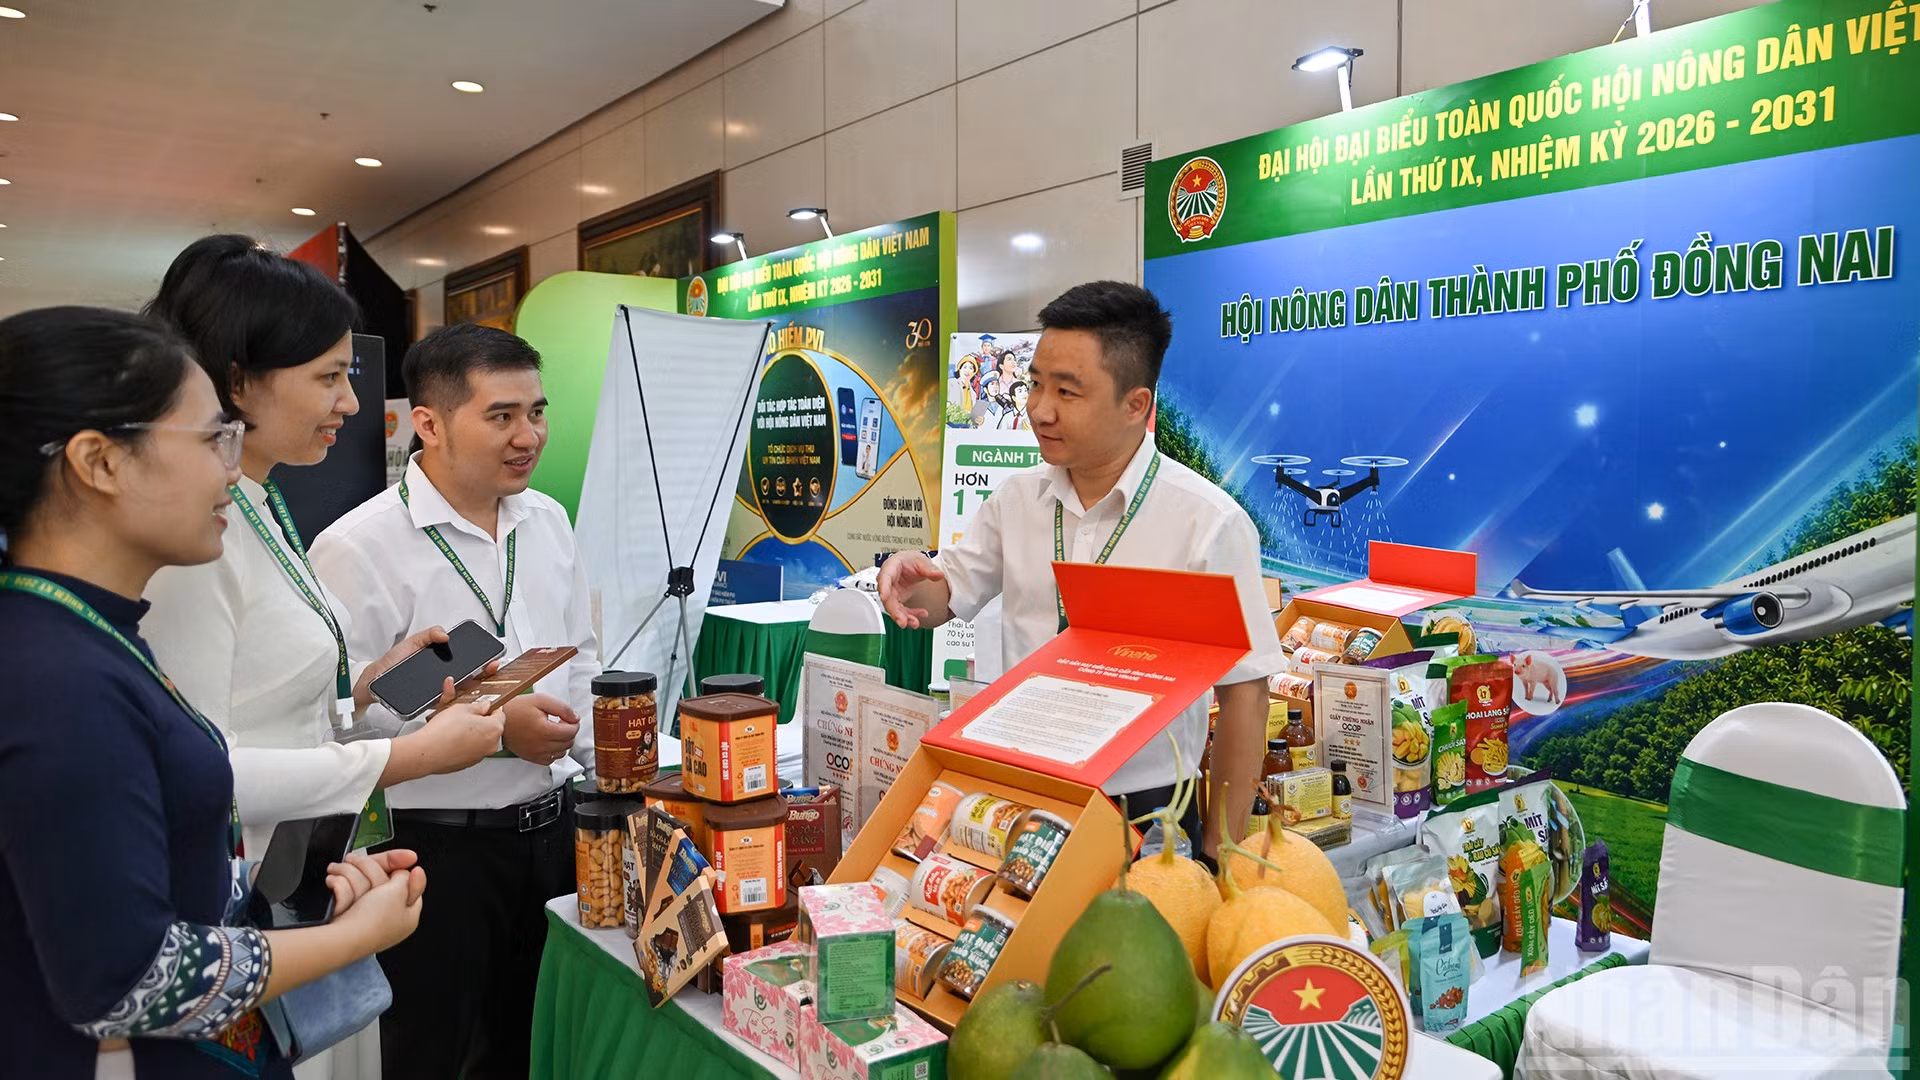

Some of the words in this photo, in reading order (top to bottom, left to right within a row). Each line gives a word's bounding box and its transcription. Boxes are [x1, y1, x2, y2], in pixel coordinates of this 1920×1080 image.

[1258, 149, 1290, 182] ĐẠI
[1295, 136, 1329, 174] HỘI
[1334, 125, 1370, 165] ĐẠI
[1376, 107, 1428, 156] BIỂU
[1435, 99, 1501, 142] TOÀN
[1508, 73, 1583, 129] QUỐC
[1591, 63, 1642, 113] HỘI
[1651, 44, 1745, 97] NÔNG
[1756, 22, 1834, 75] DÂN
[1845, 0, 1920, 56] VIỆT
[1351, 165, 1392, 206] LẦN
[1399, 154, 1447, 196] THỨ
[1451, 153, 1484, 189] IX,
[1491, 134, 1580, 179] NHIỆM
[1589, 119, 1629, 165] KỲ
[1636, 109, 1715, 156] 2026
[1726, 119, 1740, 129] -
[1750, 86, 1836, 136] 2031
[881, 233, 902, 257] VIỆT
[905, 227, 929, 249] NAM
[860, 268, 882, 290] 2031
[1220, 293, 1262, 343] HỘI
[1269, 287, 1346, 333] NÔNG
[1354, 276, 1419, 325] DÂN
[1427, 265, 1545, 319] THÀNH
[1556, 239, 1644, 308] PHỐ
[1651, 231, 1783, 300] ĐỒNG
[1797, 225, 1895, 286] NAI
[806, 327, 825, 352] PVI
[972, 448, 1024, 464] NGÀNH
[955, 473, 989, 486] HƠN
[953, 489, 964, 515] 1
[1114, 647, 1158, 661] Vinahe
[1484, 709, 1503, 718] LANG
[817, 719, 843, 735] CHỨNG
[1342, 723, 1361, 732] OCOP
[870, 756, 894, 773] CHỨNG
[1524, 812, 1543, 829] MÍT
